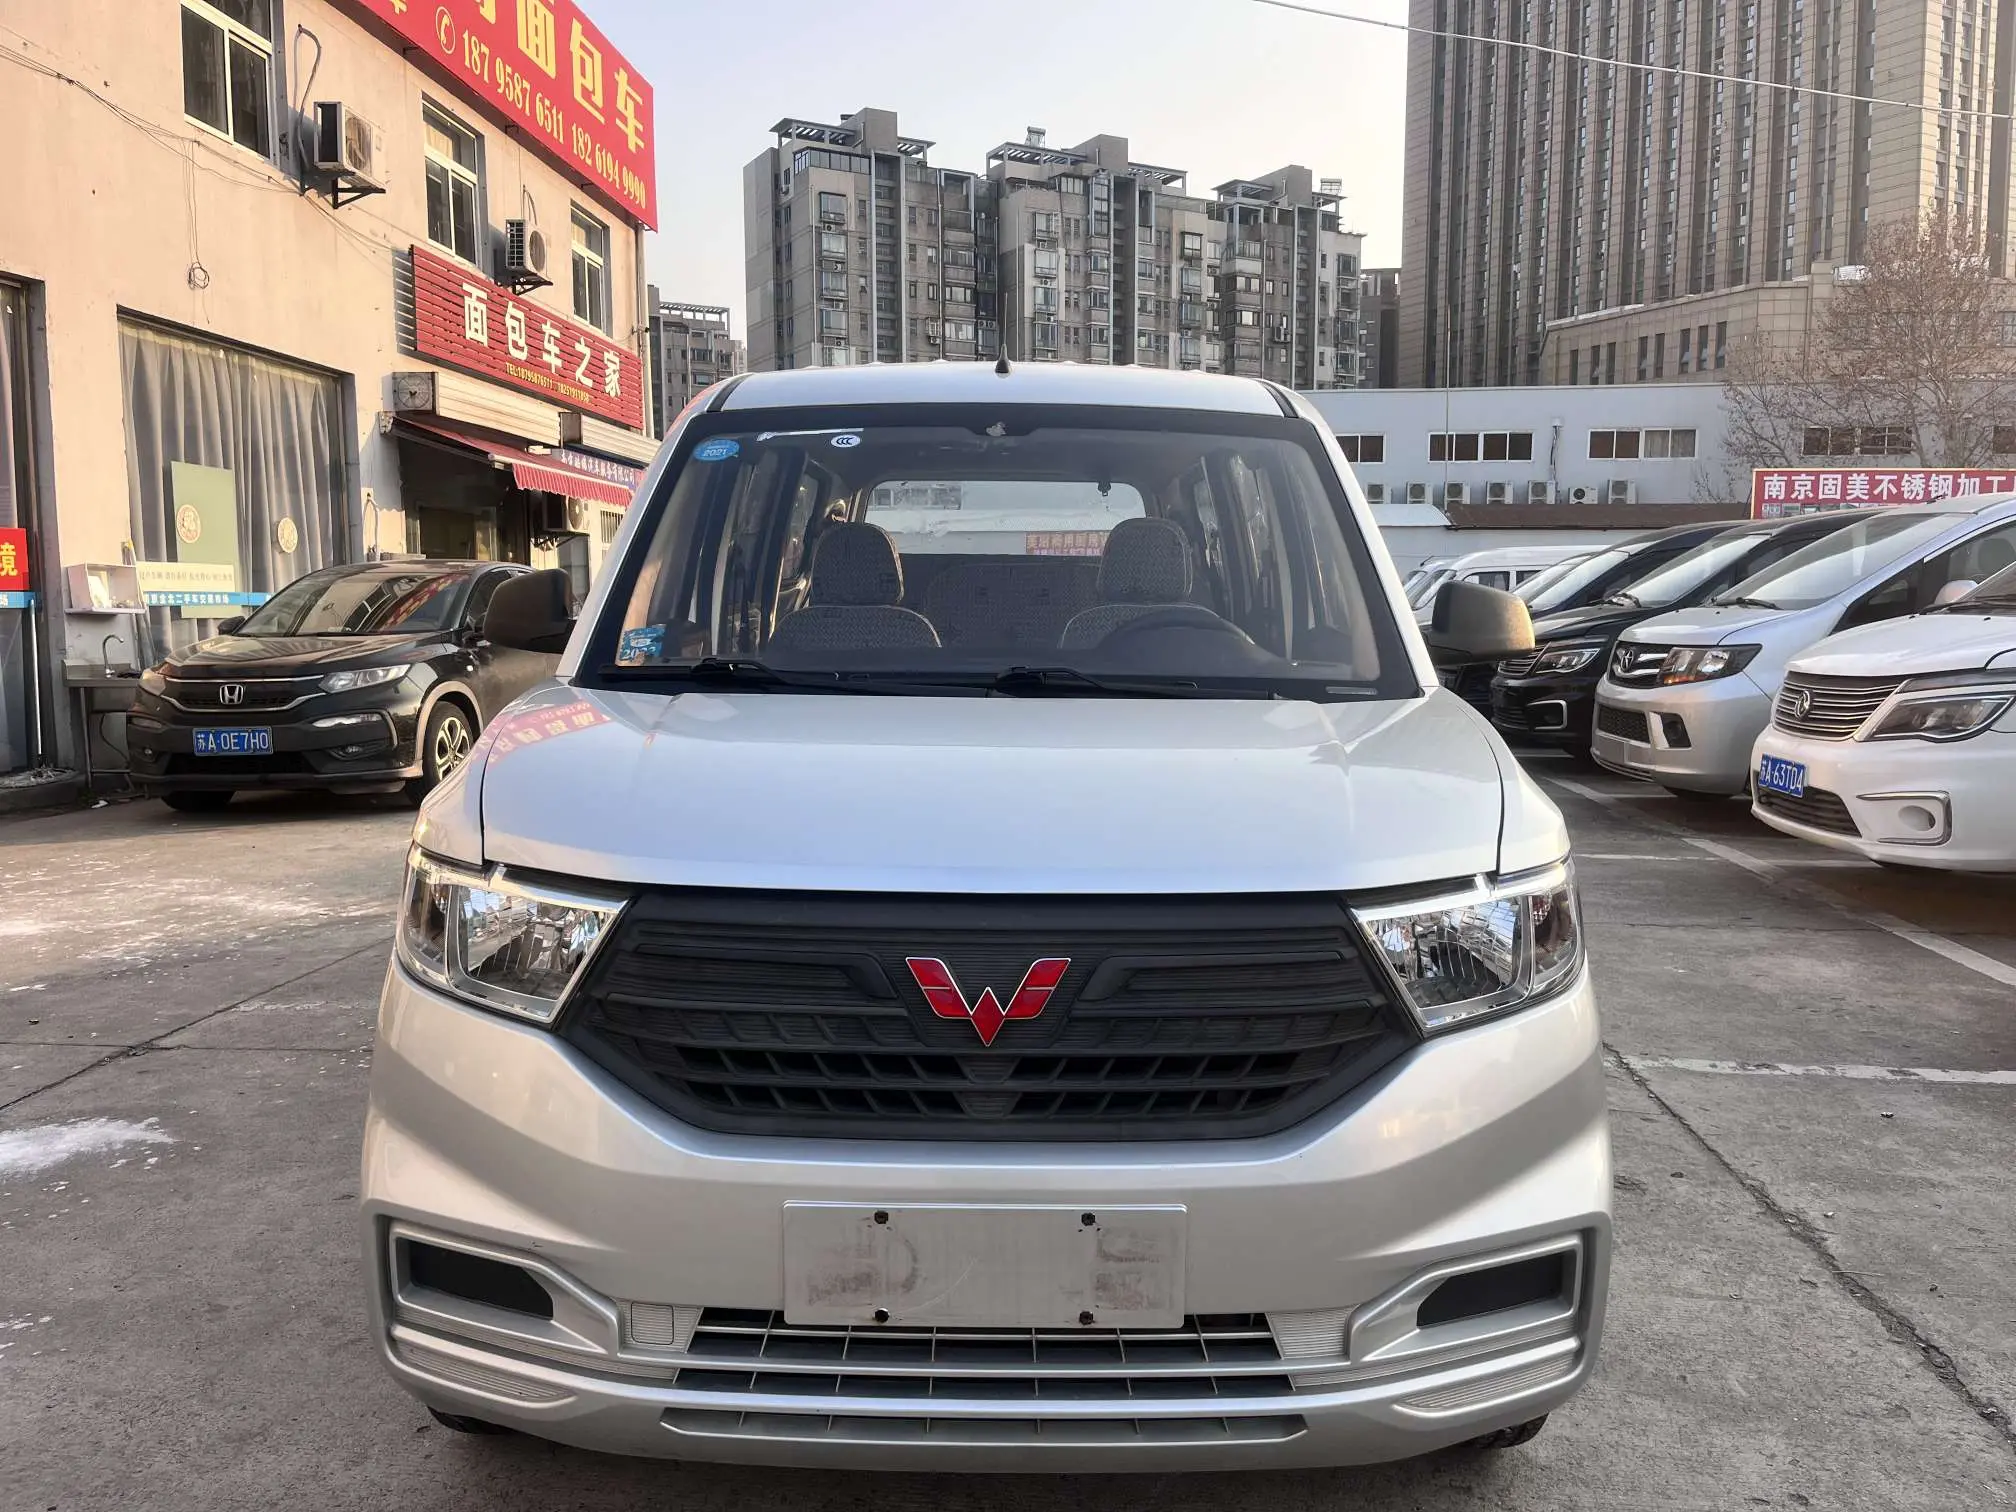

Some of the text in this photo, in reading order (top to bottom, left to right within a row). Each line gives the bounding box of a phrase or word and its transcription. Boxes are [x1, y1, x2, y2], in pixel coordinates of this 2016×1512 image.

[463, 30, 490, 83] 187
[495, 57, 531, 116] 9587
[536, 92, 564, 144] 6511
[572, 122, 592, 167] 182
[595, 143, 620, 190] 6194
[462, 282, 621, 398] 面包车之家
[1763, 472, 2016, 501] 南京固美不锈钢加工
